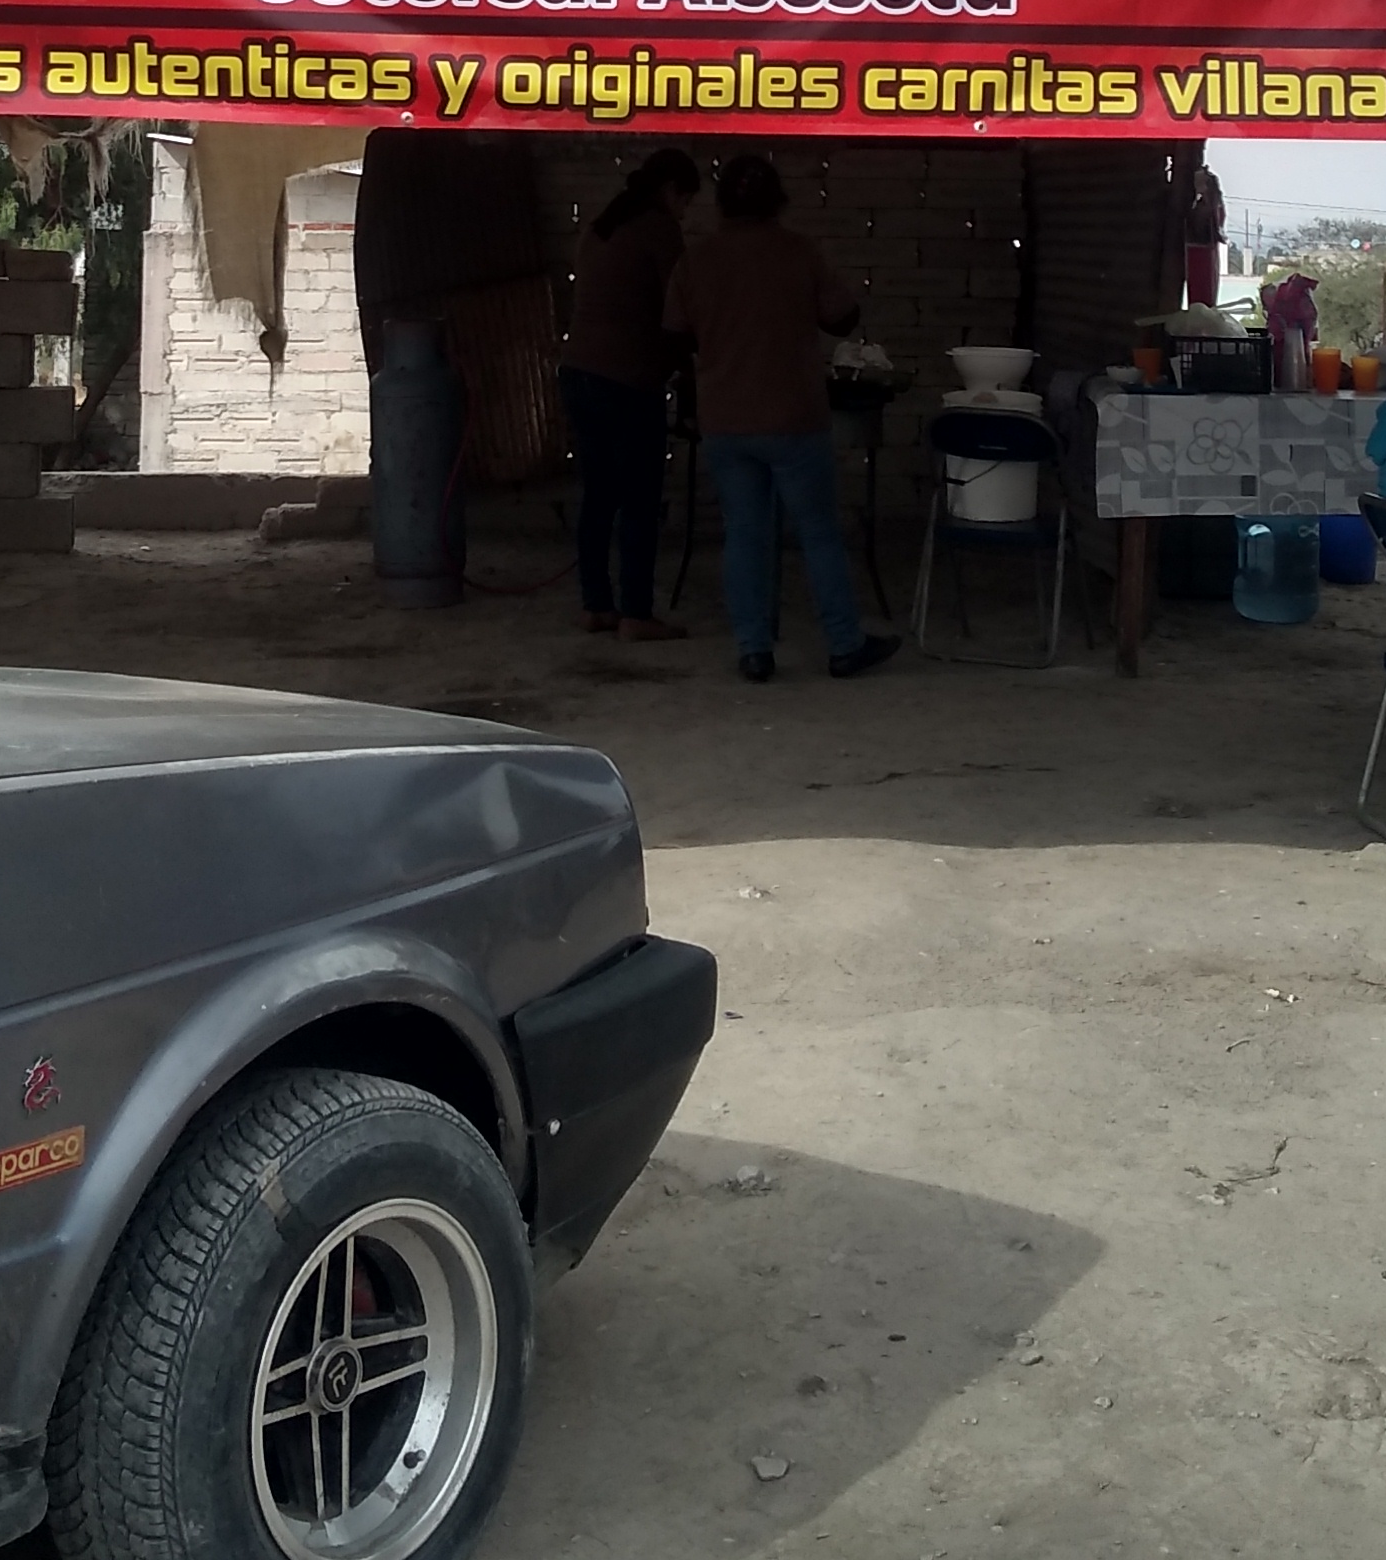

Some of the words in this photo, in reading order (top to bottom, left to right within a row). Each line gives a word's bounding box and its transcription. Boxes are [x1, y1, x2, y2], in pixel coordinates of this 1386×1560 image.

[44, 40, 412, 103] autenticas
[435, 60, 479, 116] y
[500, 50, 840, 120] originales
[862, 57, 1140, 115] carnitas
